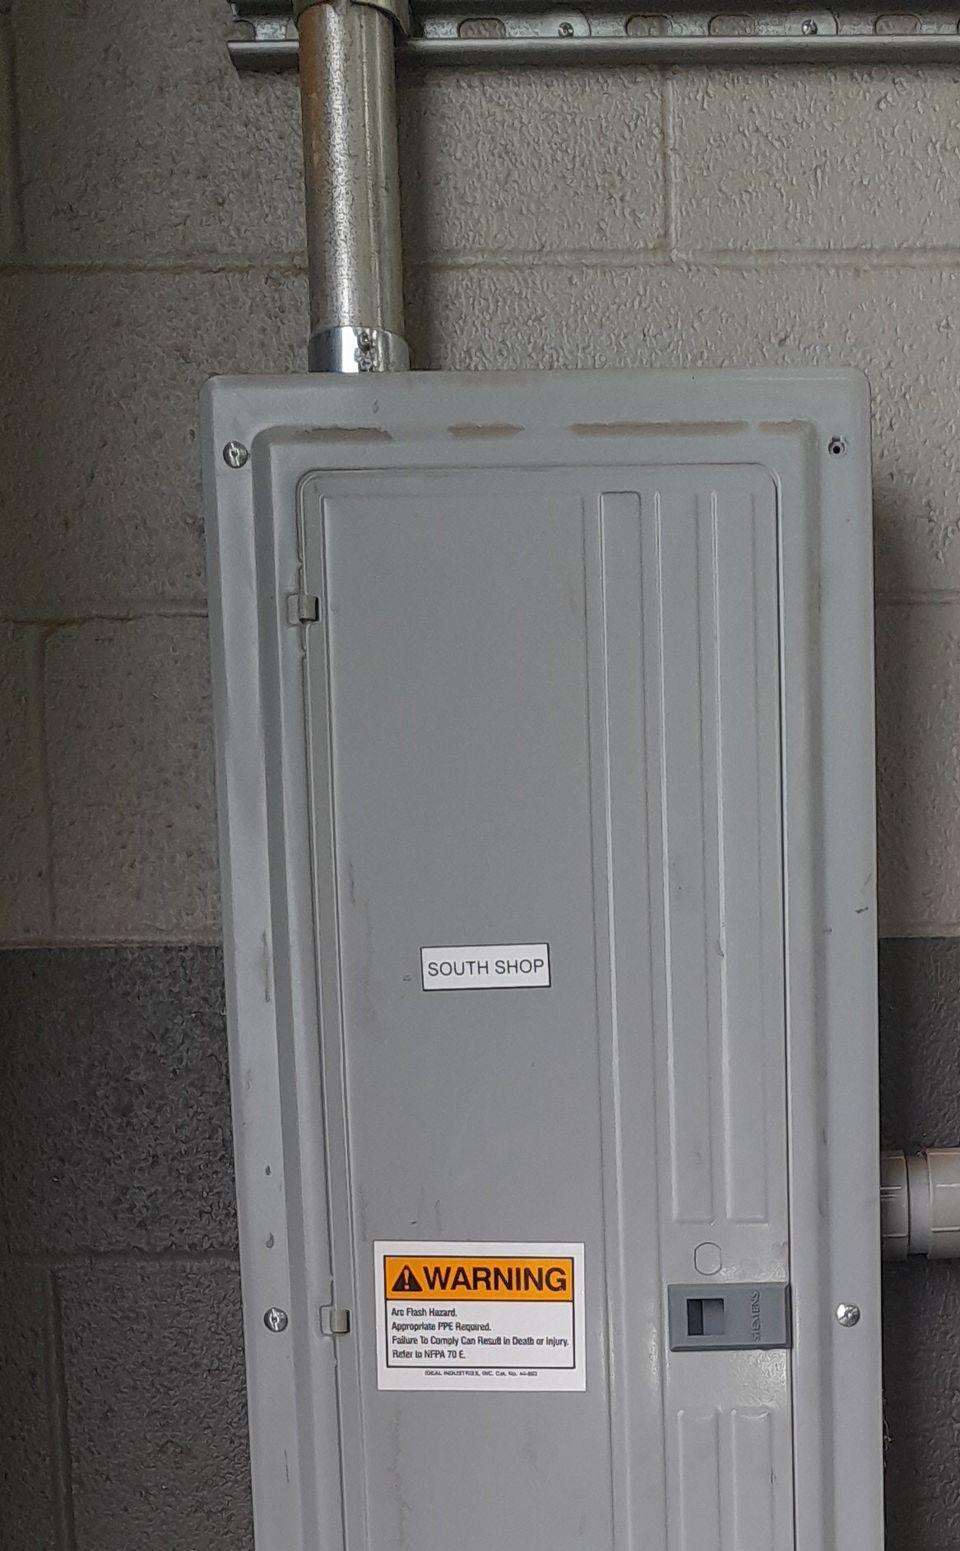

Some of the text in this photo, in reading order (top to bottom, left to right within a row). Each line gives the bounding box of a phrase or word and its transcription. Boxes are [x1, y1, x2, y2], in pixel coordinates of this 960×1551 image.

[428, 958, 544, 976] SOUTH SHOP
[423, 1266, 567, 1292] WARNING
[391, 1308, 458, 1317] Arc Flash Hazard.
[751, 1289, 760, 1342] SIEMENS
[391, 1322, 492, 1332] Appropriate PPE Required.
[392, 1336, 569, 1348] Failure To Comply Can Result in Death or Injury.
[392, 1350, 466, 1360] Refer to NFPA 70 E.
